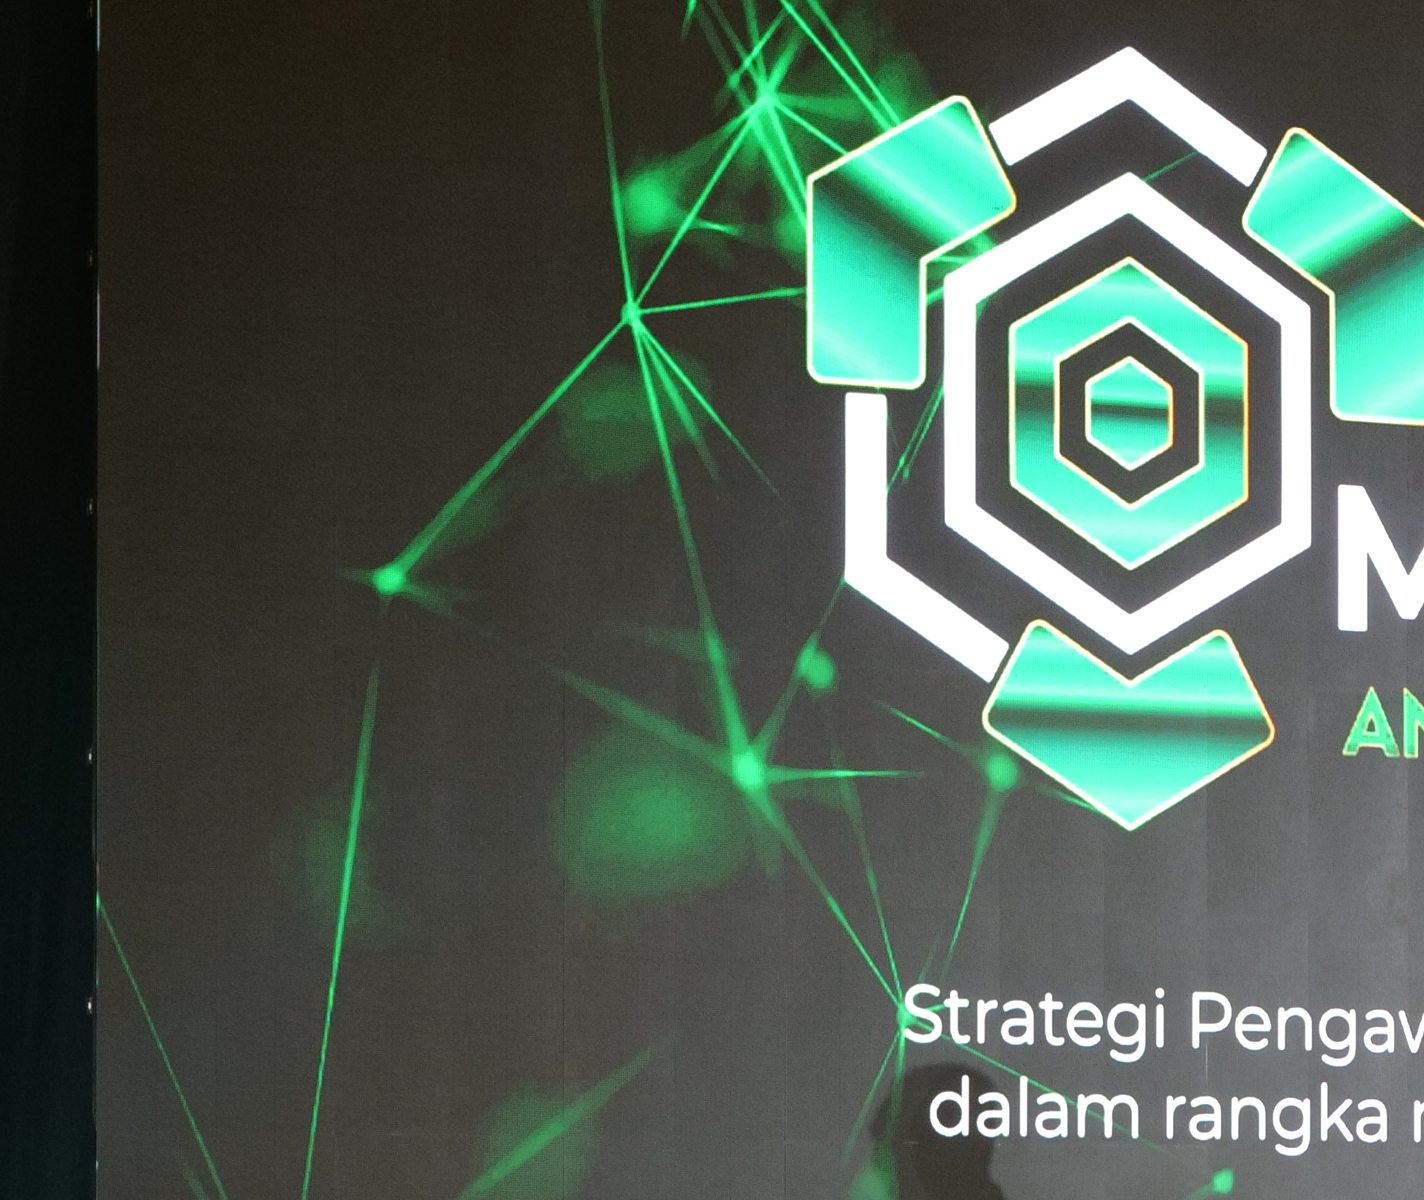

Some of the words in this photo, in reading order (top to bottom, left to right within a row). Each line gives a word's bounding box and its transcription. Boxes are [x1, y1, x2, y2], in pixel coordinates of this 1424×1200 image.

[902, 983, 1165, 1063] Strategi
[929, 1074, 1139, 1139] dalam
[1165, 1081, 1388, 1157] rangka
